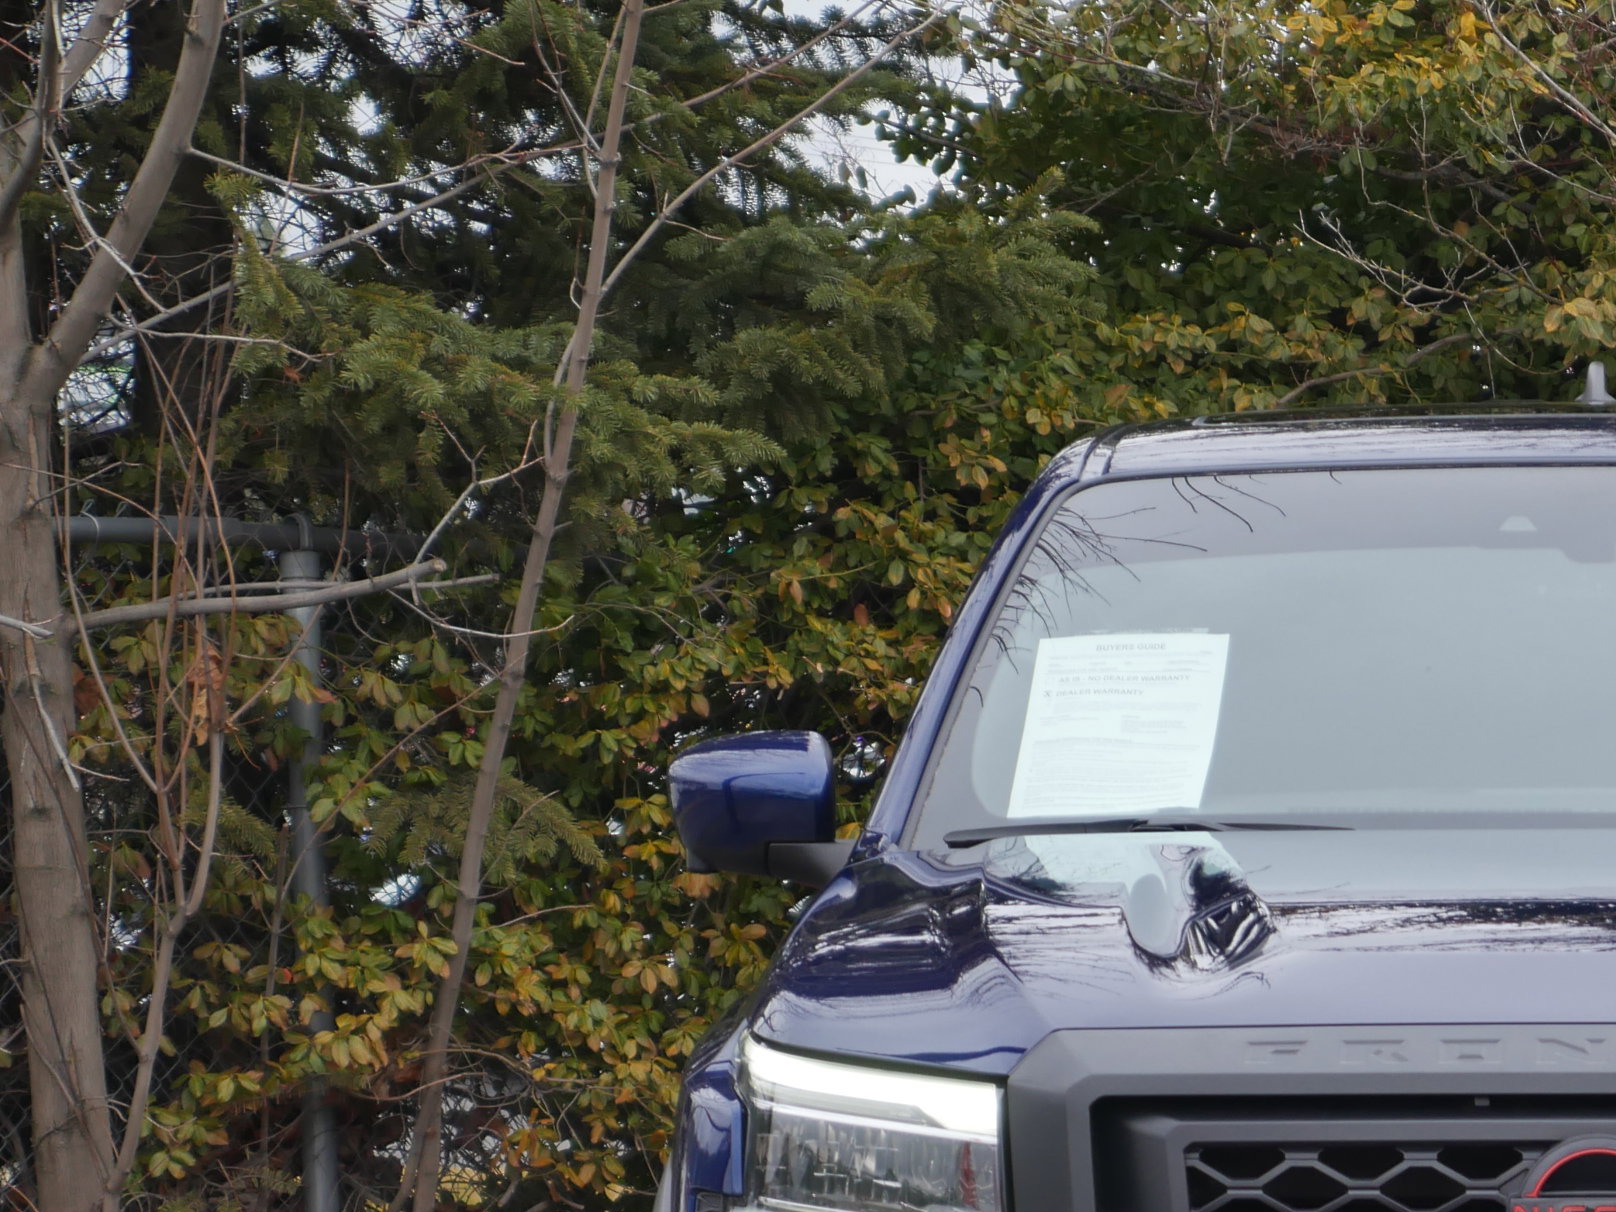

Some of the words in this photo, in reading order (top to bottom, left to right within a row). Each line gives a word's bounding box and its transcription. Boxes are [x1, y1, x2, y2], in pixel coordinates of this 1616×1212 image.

[1095, 642, 1134, 652] BUYERS
[1136, 642, 1167, 651] GUIDE
[1141, 674, 1191, 682] WARRANTY
[1056, 688, 1091, 697] DEALER
[1092, 687, 1144, 696] WARRANTY
